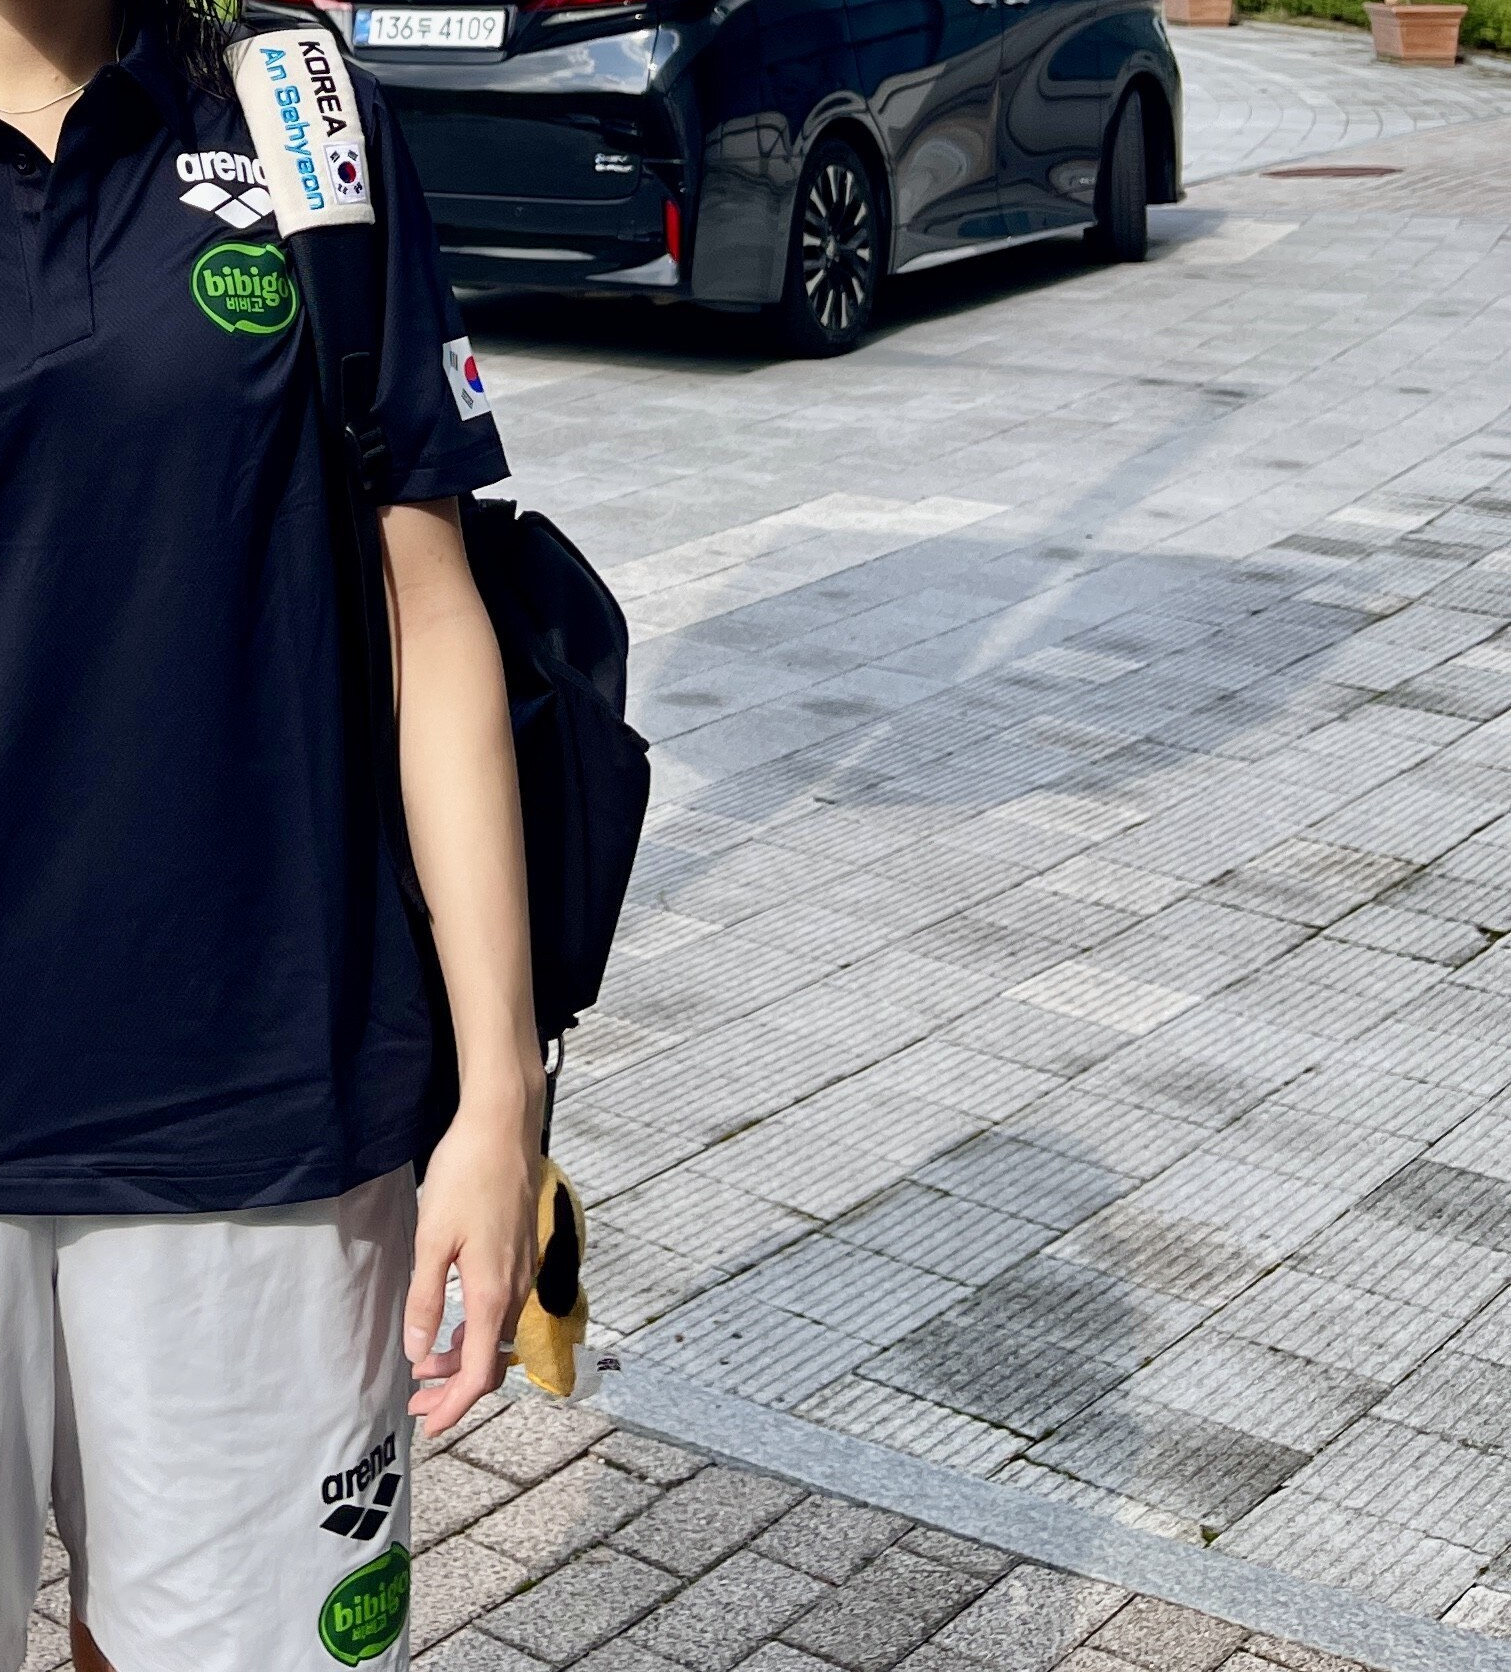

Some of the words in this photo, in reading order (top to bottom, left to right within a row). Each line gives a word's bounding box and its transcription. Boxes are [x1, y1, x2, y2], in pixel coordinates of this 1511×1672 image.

[439, 16, 497, 41] 4109
[259, 47, 288, 82] An
[297, 40, 348, 138] KOREA
[273, 84, 326, 211] Sehyeon
[225, 296, 265, 313] 비비고
[321, 1431, 397, 1505] arena
